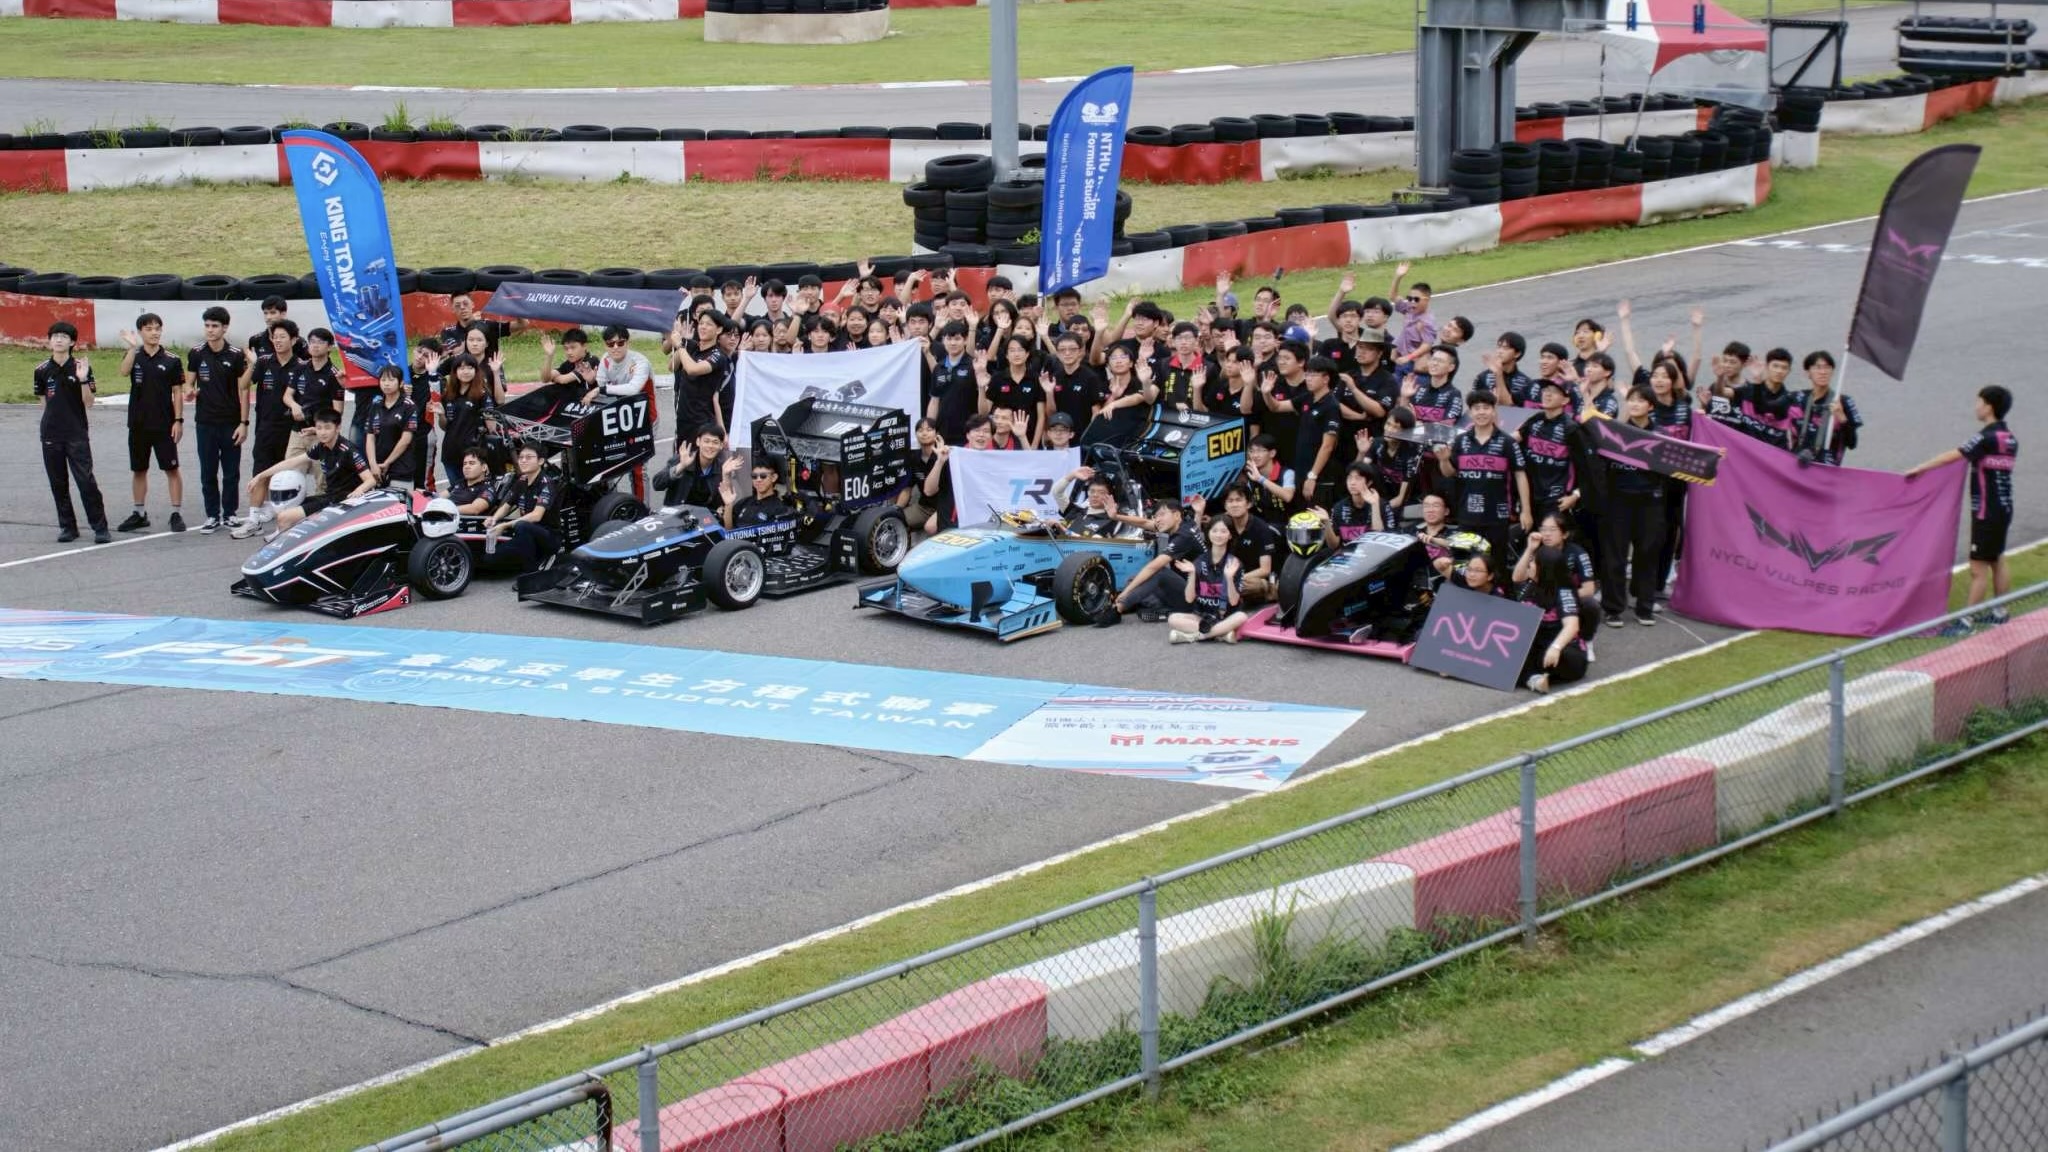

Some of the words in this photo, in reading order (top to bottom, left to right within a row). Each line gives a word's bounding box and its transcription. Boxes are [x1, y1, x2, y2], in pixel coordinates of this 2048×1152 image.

[1085, 132, 1098, 177] Formula
[1098, 132, 1113, 173] NTHU
[324, 196, 349, 243] KING
[333, 243, 358, 295] TONY
[525, 292, 560, 304] TAIWAN
[561, 294, 585, 307] TECH
[587, 297, 628, 310] RACING
[601, 400, 647, 436] E07
[1208, 427, 1242, 459] E107
[844, 475, 869, 500] E06
[724, 529, 756, 541] NATIONAL
[758, 524, 776, 536] TSING
[1709, 547, 1758, 571] NYCU
[1765, 564, 1839, 596] VULPES
[1845, 576, 1907, 596] RACING
[101, 640, 392, 668] FST
[372, 668, 569, 691] FORMULA
[588, 686, 791, 711] STUDENT
[808, 706, 976, 730] TAIWAN
[1154, 736, 1301, 747] MAXXIS
